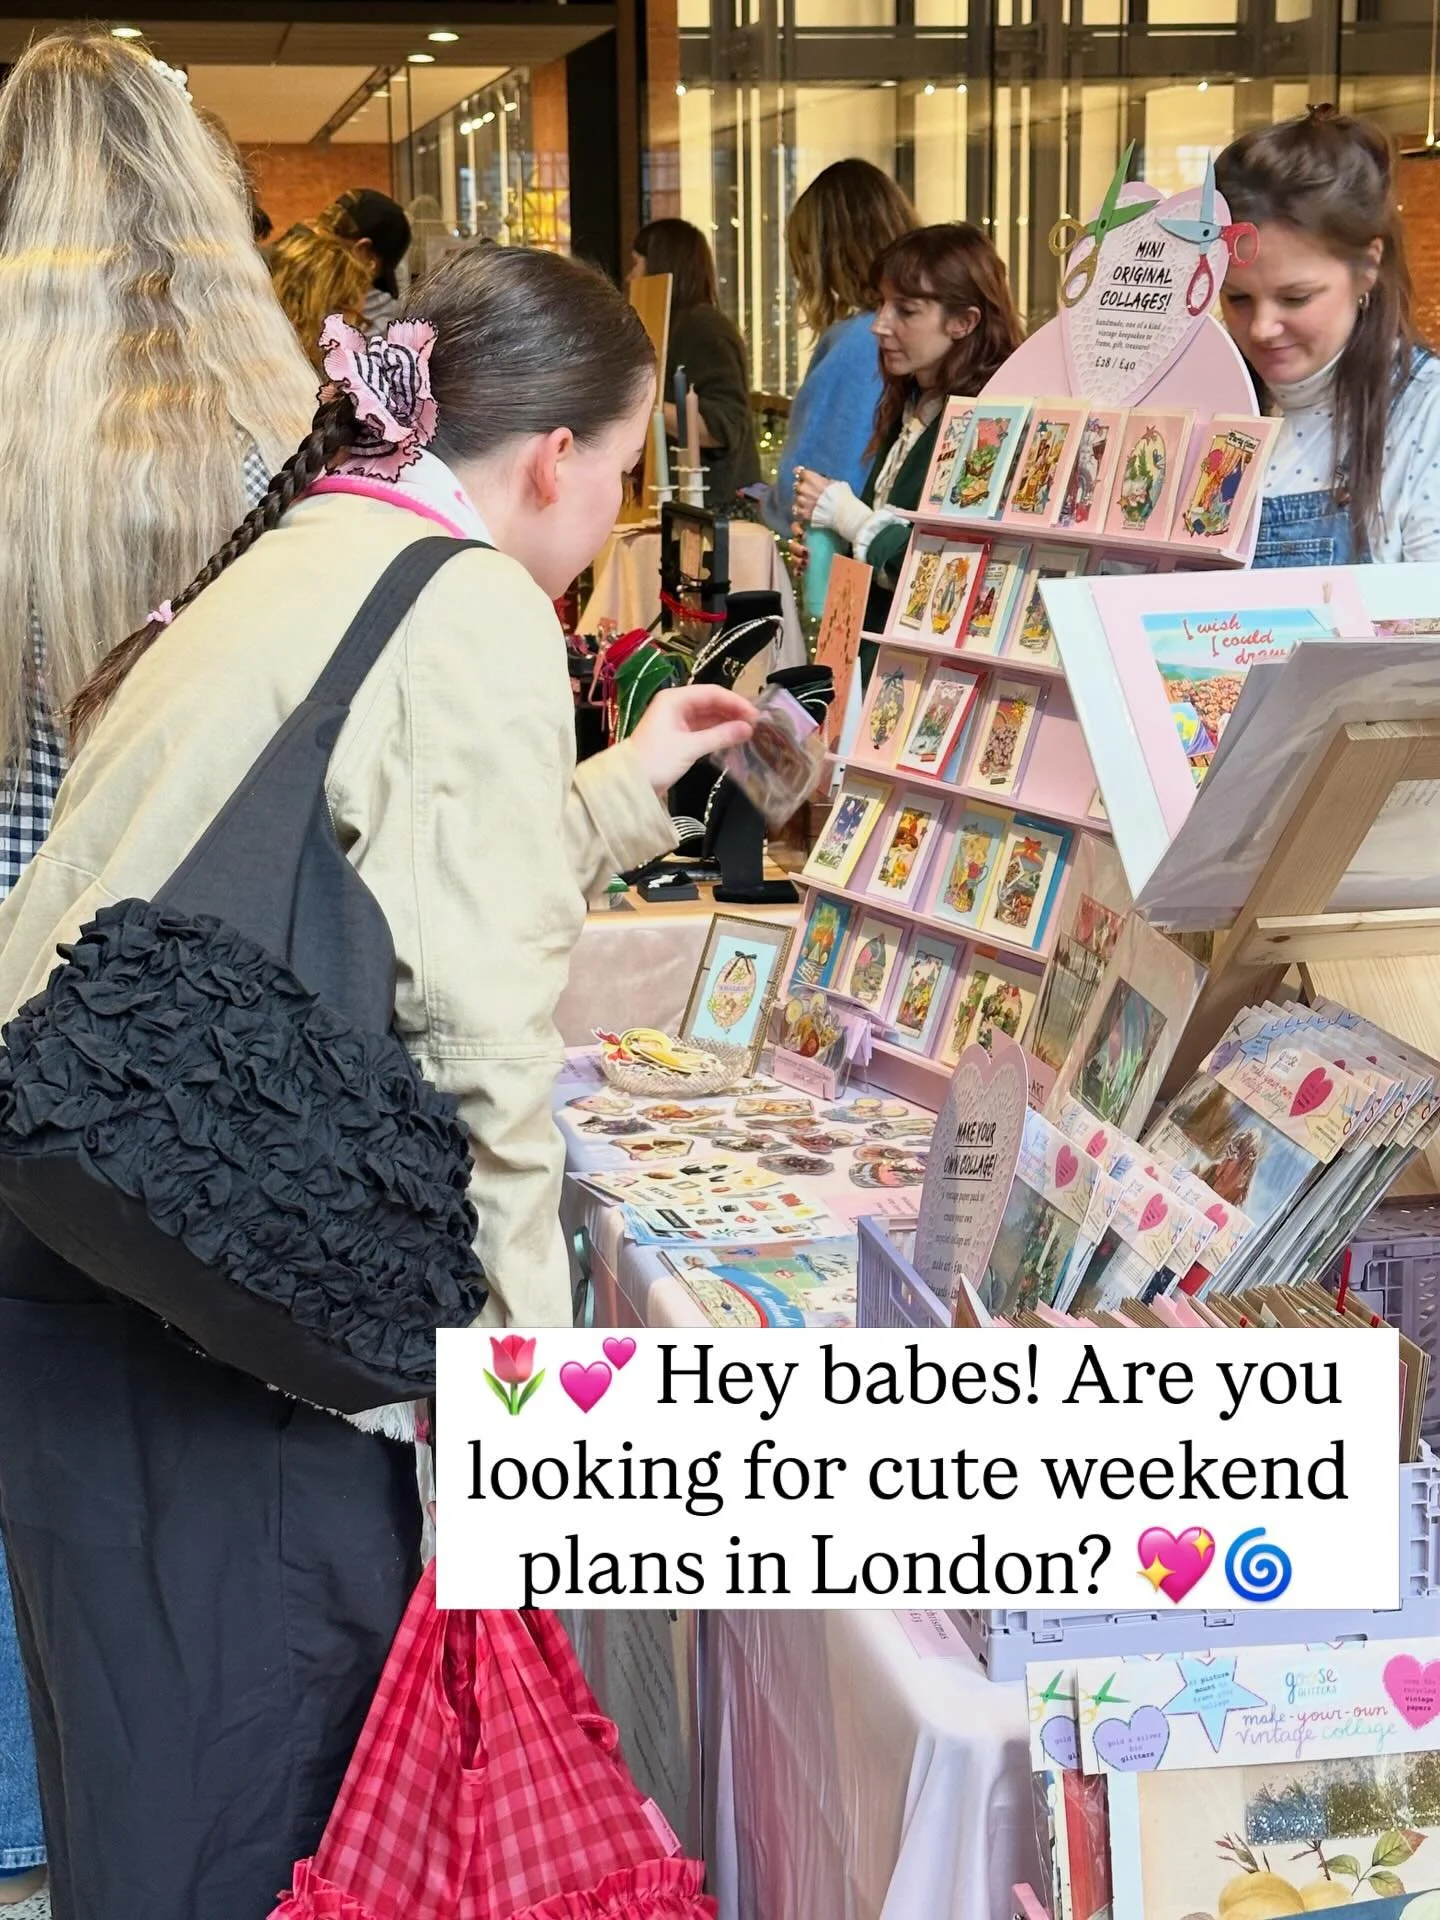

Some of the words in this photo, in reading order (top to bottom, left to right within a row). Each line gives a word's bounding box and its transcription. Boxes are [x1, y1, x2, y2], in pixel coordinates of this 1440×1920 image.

[1136, 241, 1166, 258] MINI
[1113, 266, 1173, 285] ORIGINAL
[1100, 291, 1173, 312] COLLAGES!
[1095, 356, 1112, 369] £28
[1118, 358, 1136, 372] £40
[1183, 619, 1194, 641] I
[1197, 613, 1241, 634] wish
[1211, 635, 1220, 657] I
[1222, 629, 1275, 648] could
[956, 1121, 977, 1144] MAKE
[976, 1121, 996, 1144] YOUR
[943, 1154, 959, 1175] OWN
[959, 1153, 998, 1178] COLLAGE!
[1405, 1696, 1434, 1704] vintage
[1242, 1704, 1388, 1730] make-your-own
[1235, 1726, 1316, 1758] vintage
[1322, 1719, 1400, 1752] collage
[1120, 1752, 1155, 1763] glitters
